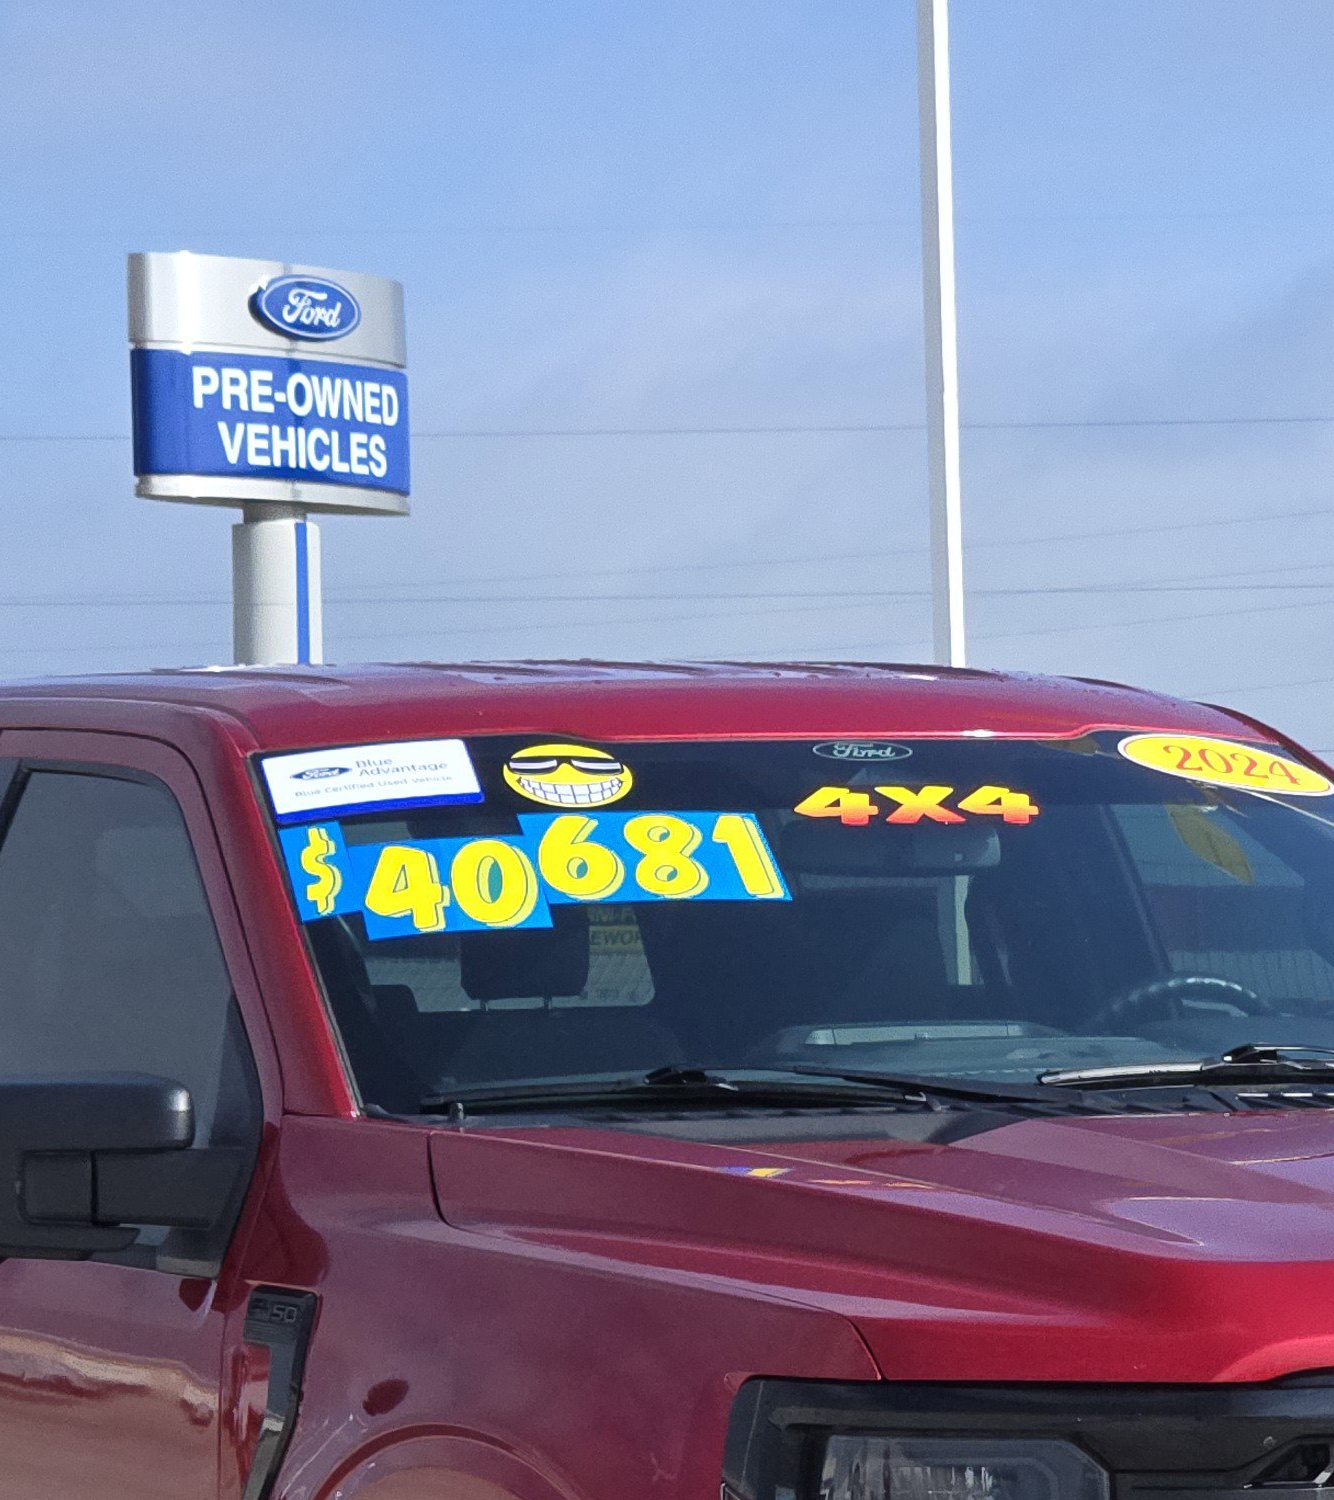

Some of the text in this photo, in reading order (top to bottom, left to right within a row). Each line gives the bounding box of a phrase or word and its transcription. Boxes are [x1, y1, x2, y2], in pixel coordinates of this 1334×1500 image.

[282, 288, 342, 328] Ford
[192, 366, 399, 426] PRE-OWNED
[218, 421, 387, 477] VEHICLES
[355, 758, 393, 769] Blue
[359, 761, 448, 777] Advantage
[832, 742, 896, 758] Ford
[1162, 745, 1301, 785] 2024
